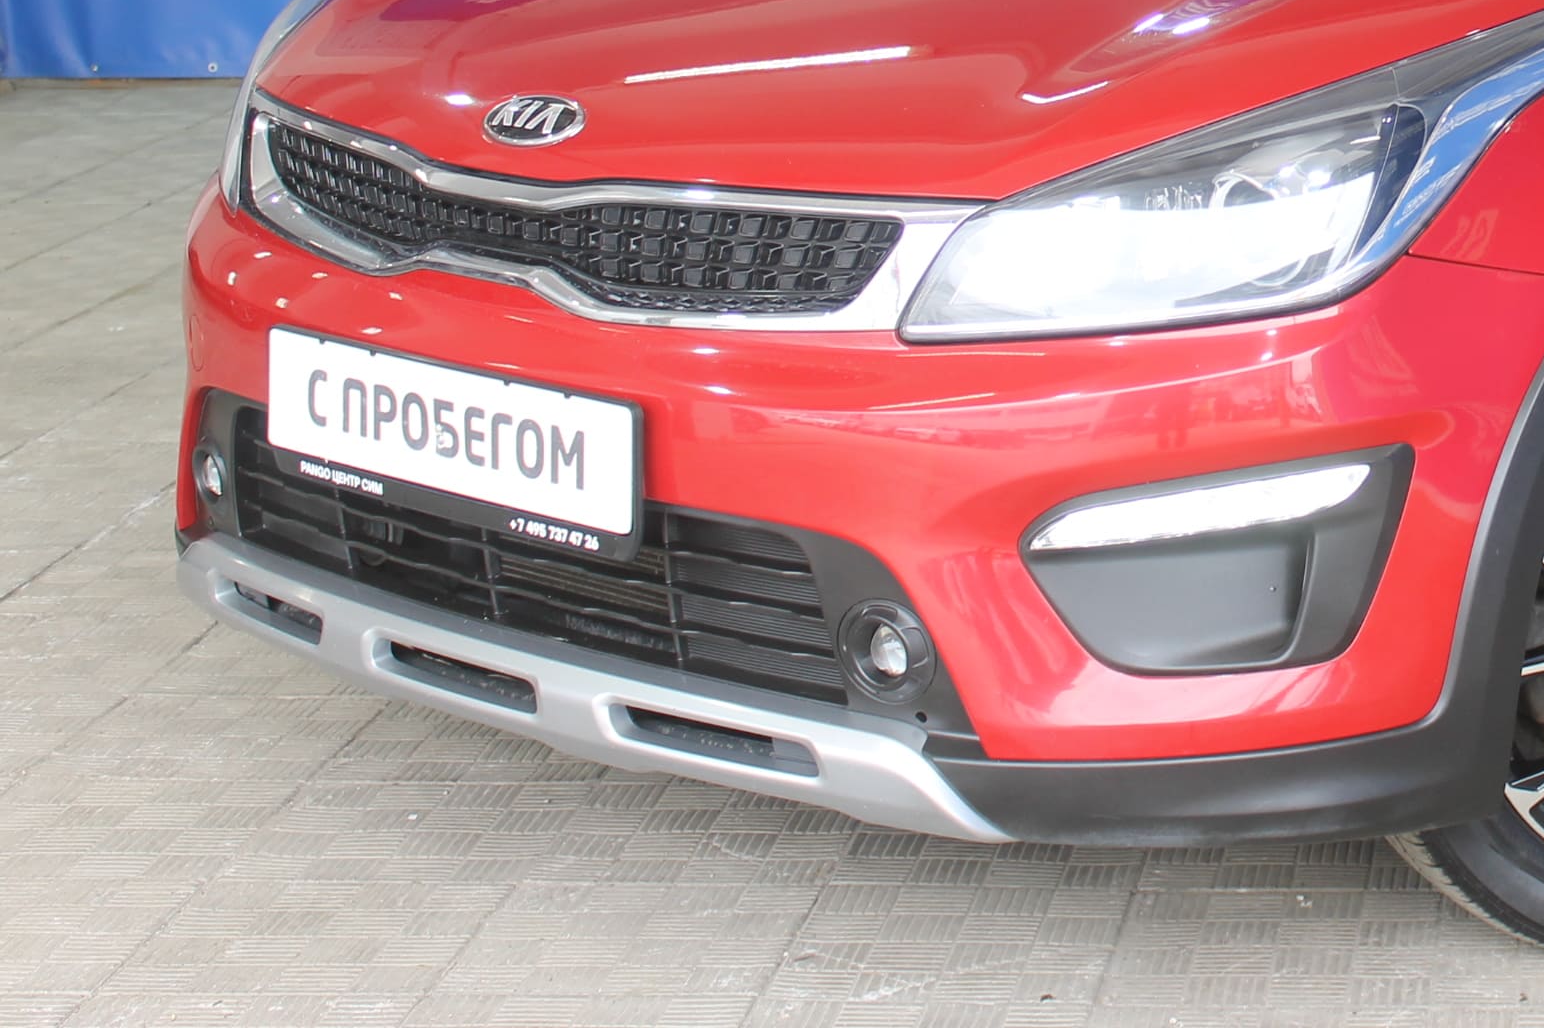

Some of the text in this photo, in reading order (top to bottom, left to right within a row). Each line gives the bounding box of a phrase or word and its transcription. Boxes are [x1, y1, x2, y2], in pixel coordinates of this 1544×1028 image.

[491, 99, 577, 135] KIA
[308, 369, 585, 491] С ПРОБЕГОМ
[300, 460, 384, 496] PANGO ЦЕНТР СИМ
[510, 518, 525, 532] +7
[526, 521, 547, 538] 495
[584, 534, 599, 550] 26
